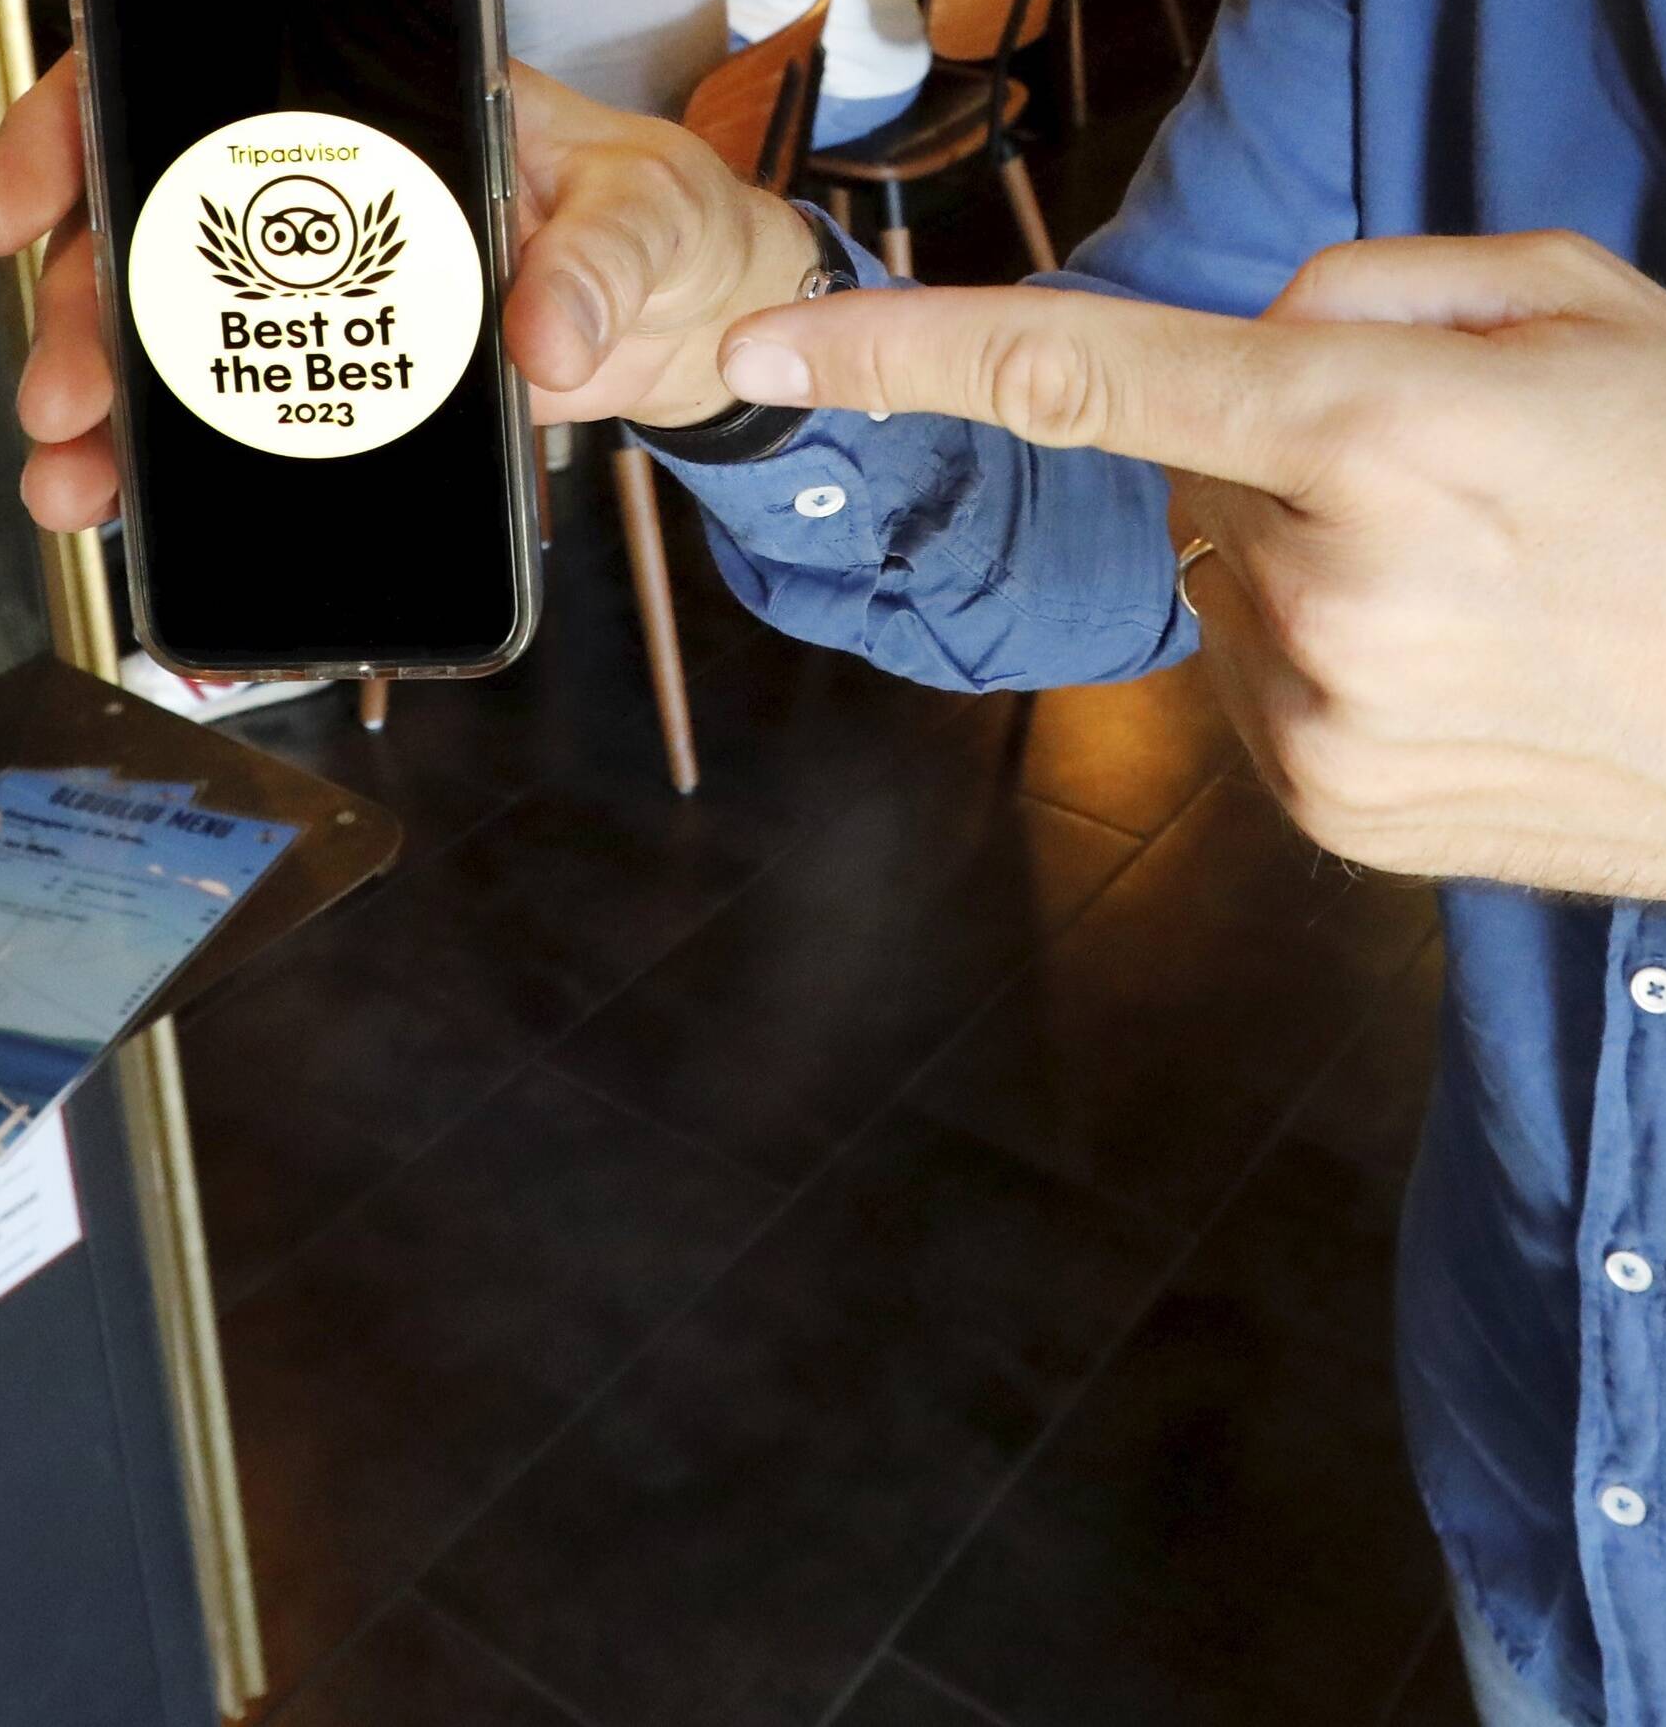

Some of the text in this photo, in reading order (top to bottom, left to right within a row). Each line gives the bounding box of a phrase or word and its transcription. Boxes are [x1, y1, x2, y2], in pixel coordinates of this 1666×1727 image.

[227, 143, 361, 167] Tripadvisor
[220, 305, 397, 350] Best of
[210, 352, 415, 393] the Best
[276, 402, 356, 428] 2023
